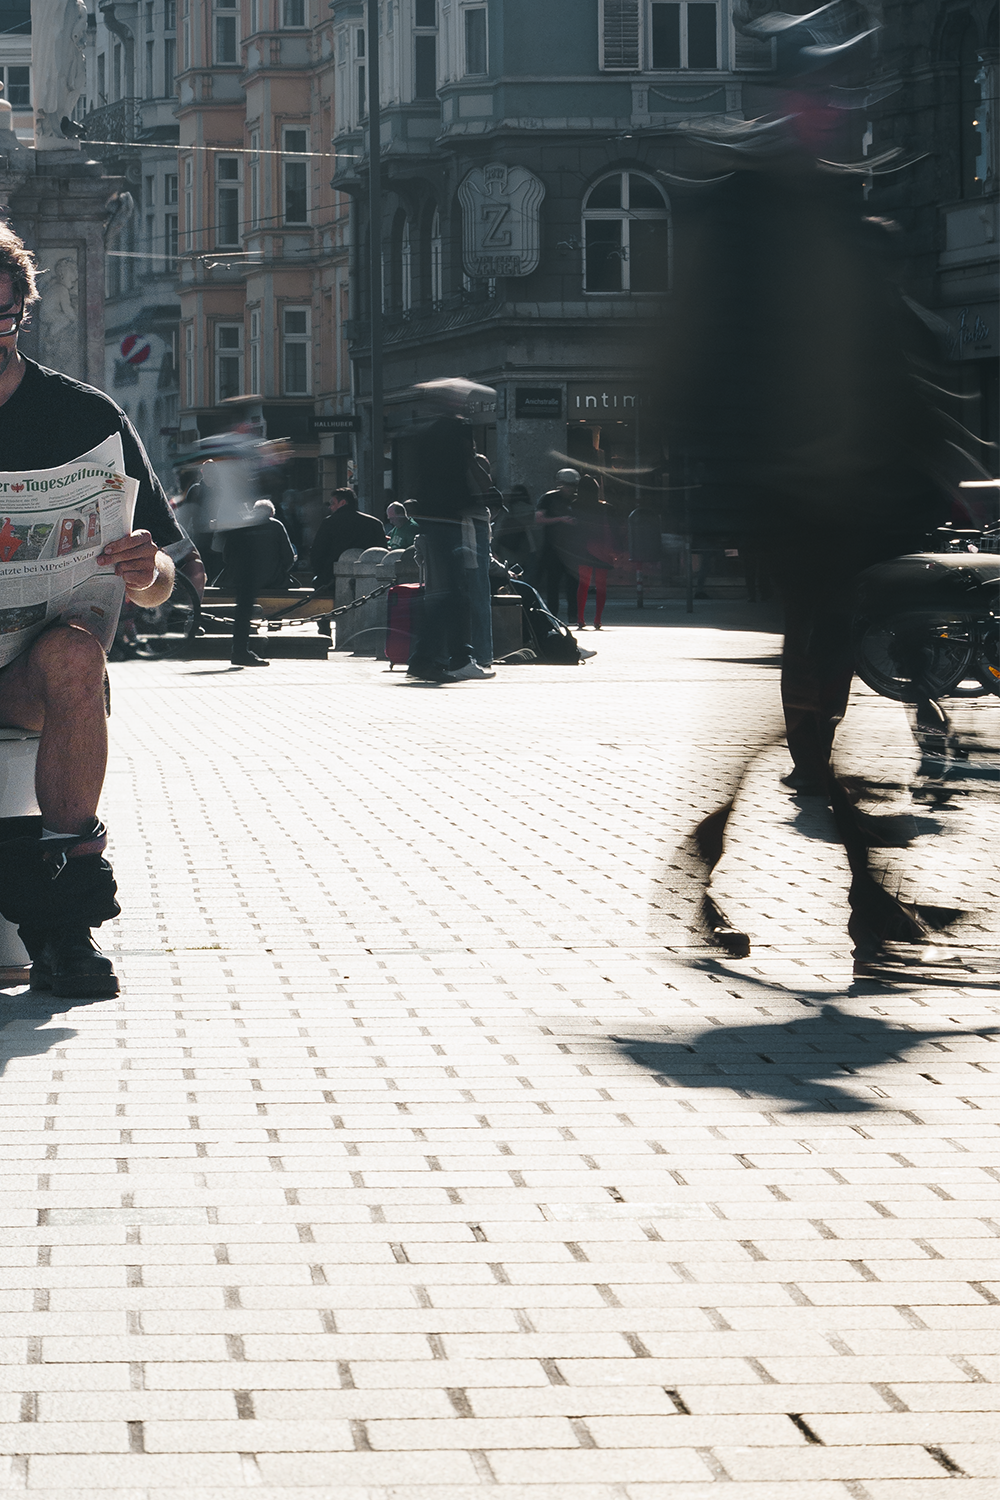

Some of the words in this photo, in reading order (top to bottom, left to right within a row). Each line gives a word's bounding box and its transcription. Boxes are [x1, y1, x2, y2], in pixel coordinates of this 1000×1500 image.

[480, 203, 512, 248] Z
[576, 392, 643, 408] intim
[23, 565, 38, 574] bei
